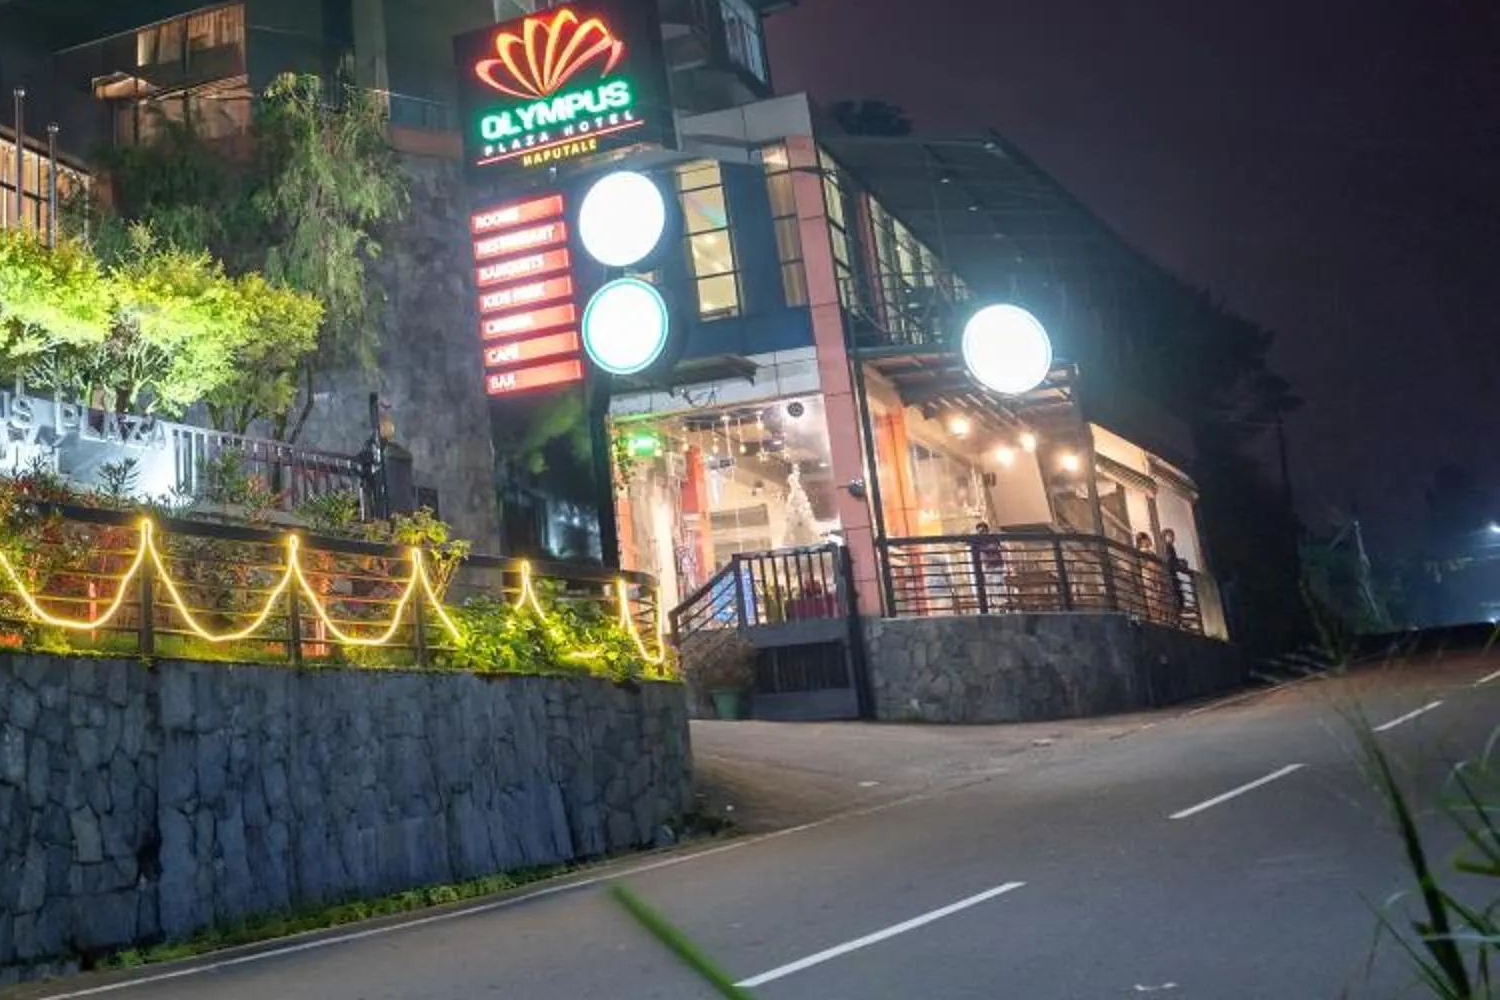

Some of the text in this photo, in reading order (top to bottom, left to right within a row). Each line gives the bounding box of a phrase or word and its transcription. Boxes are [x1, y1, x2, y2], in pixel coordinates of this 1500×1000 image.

[481, 81, 629, 140] OLYMPUS
[484, 111, 634, 157] PLAZA HOTEL
[523, 138, 597, 167] HAPUTALE
[55, 399, 167, 450] PLAZA
